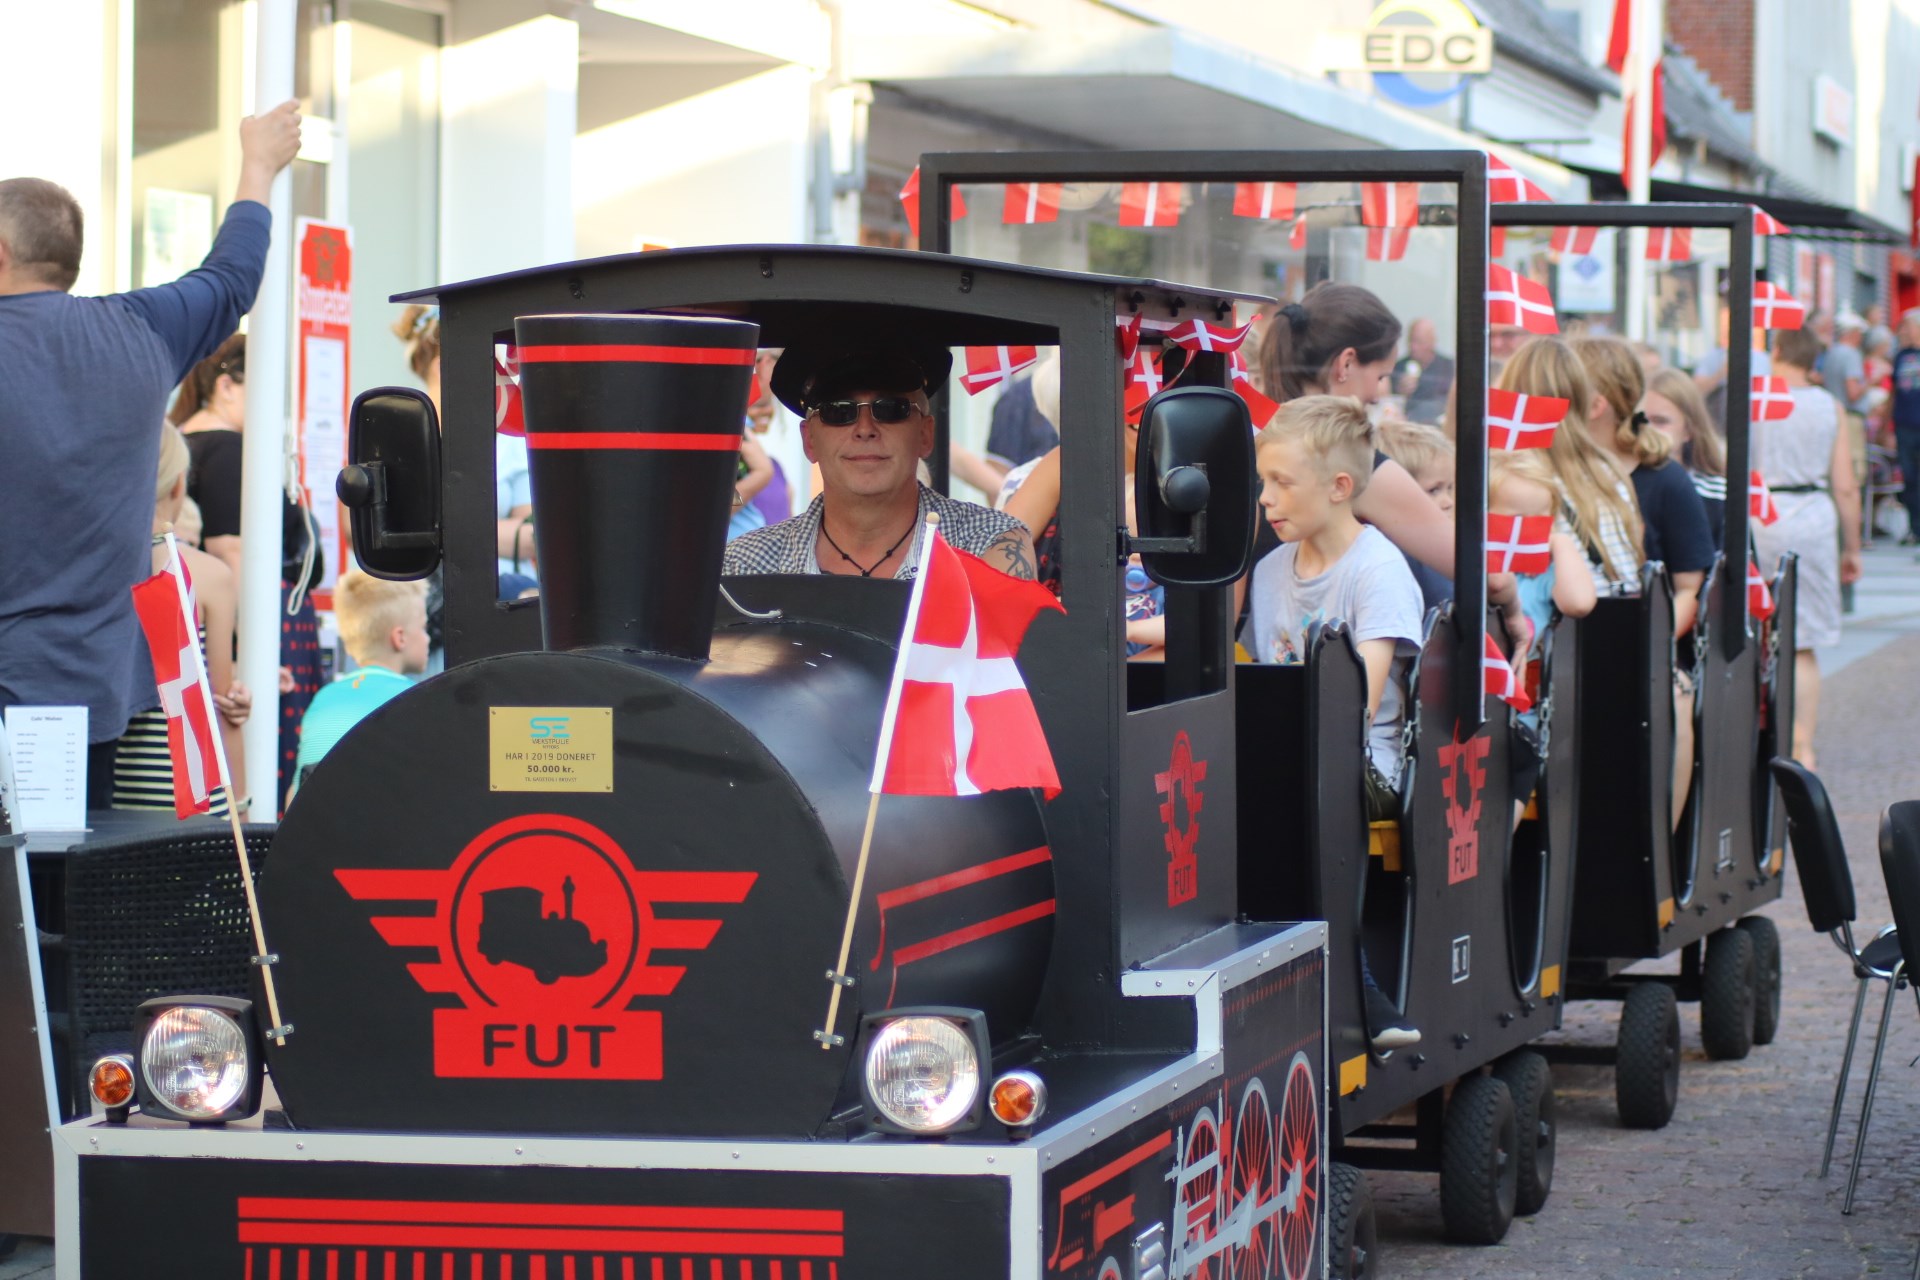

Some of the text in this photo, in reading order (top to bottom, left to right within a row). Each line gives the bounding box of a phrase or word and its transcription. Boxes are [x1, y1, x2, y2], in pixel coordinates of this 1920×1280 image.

[1365, 33, 1476, 65] EDC
[530, 717, 571, 738] SE
[505, 752, 523, 761] HAR
[532, 752, 554, 761] 2019
[556, 753, 597, 761] DONERET
[527, 765, 575, 773] 50.000 kr.
[1454, 842, 1473, 876] FUT
[1174, 864, 1192, 898] FUT
[483, 1024, 617, 1069] FUT
